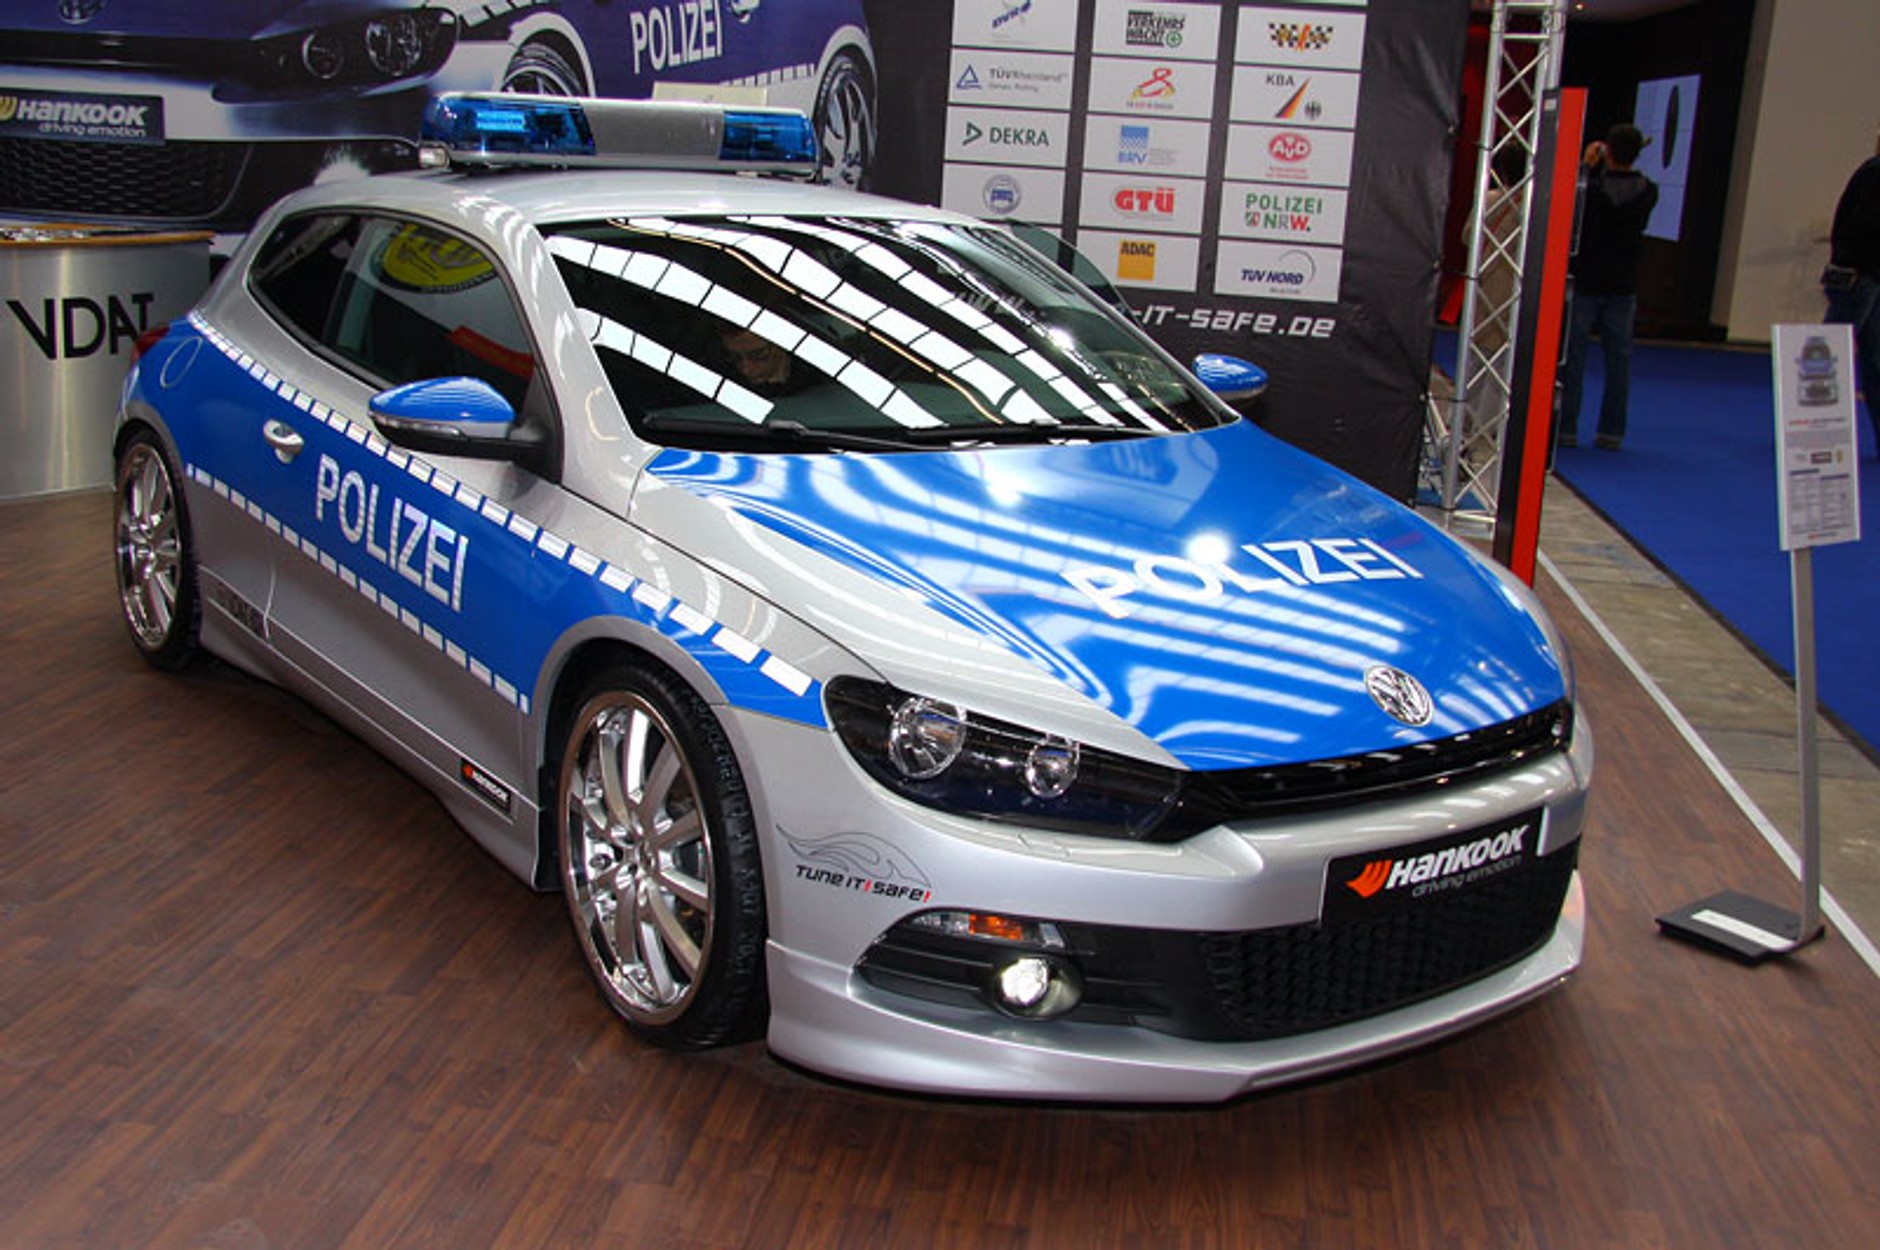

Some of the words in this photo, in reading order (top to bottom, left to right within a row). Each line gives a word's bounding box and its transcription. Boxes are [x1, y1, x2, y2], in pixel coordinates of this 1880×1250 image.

[630, 0, 723, 75] POLIZEI
[1266, 74, 1296, 88] KBA
[38, 121, 87, 137] driving
[87, 124, 148, 138] emotion
[988, 126, 1051, 147] DEKRA
[1114, 186, 1176, 214] GTÜ
[1244, 192, 1323, 215] POLIZEI
[1120, 241, 1156, 258] ADAC
[1241, 267, 1265, 282] TÜV
[1266, 271, 1305, 286] NORD
[6, 292, 155, 360] VDAT
[315, 452, 469, 613] POLIZEI
[1060, 537, 1425, 619] POLIZEI
[1411, 874, 1464, 898] driving
[1466, 854, 1523, 883] emotion
